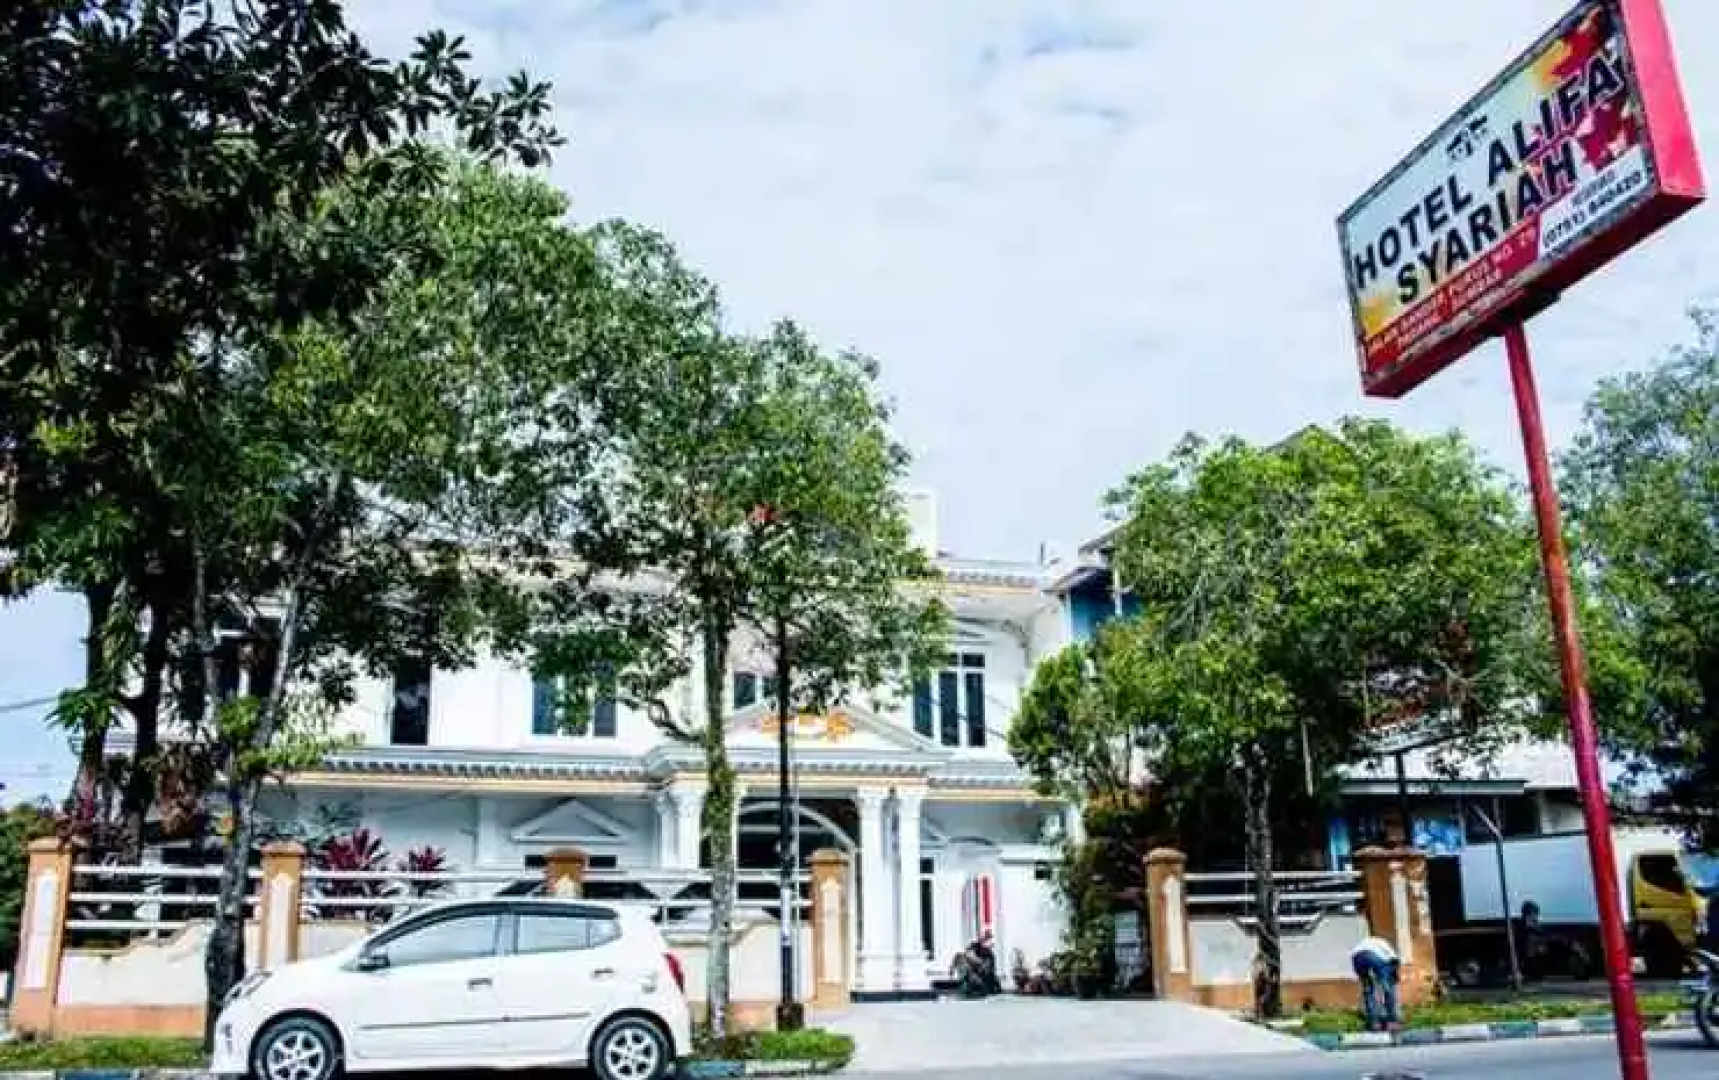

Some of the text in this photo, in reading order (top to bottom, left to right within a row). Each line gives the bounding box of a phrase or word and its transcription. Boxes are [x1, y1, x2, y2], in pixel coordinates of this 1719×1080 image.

[1354, 53, 1623, 288] HOTEL ALIFA
[1397, 140, 1578, 304] SYARIAH
